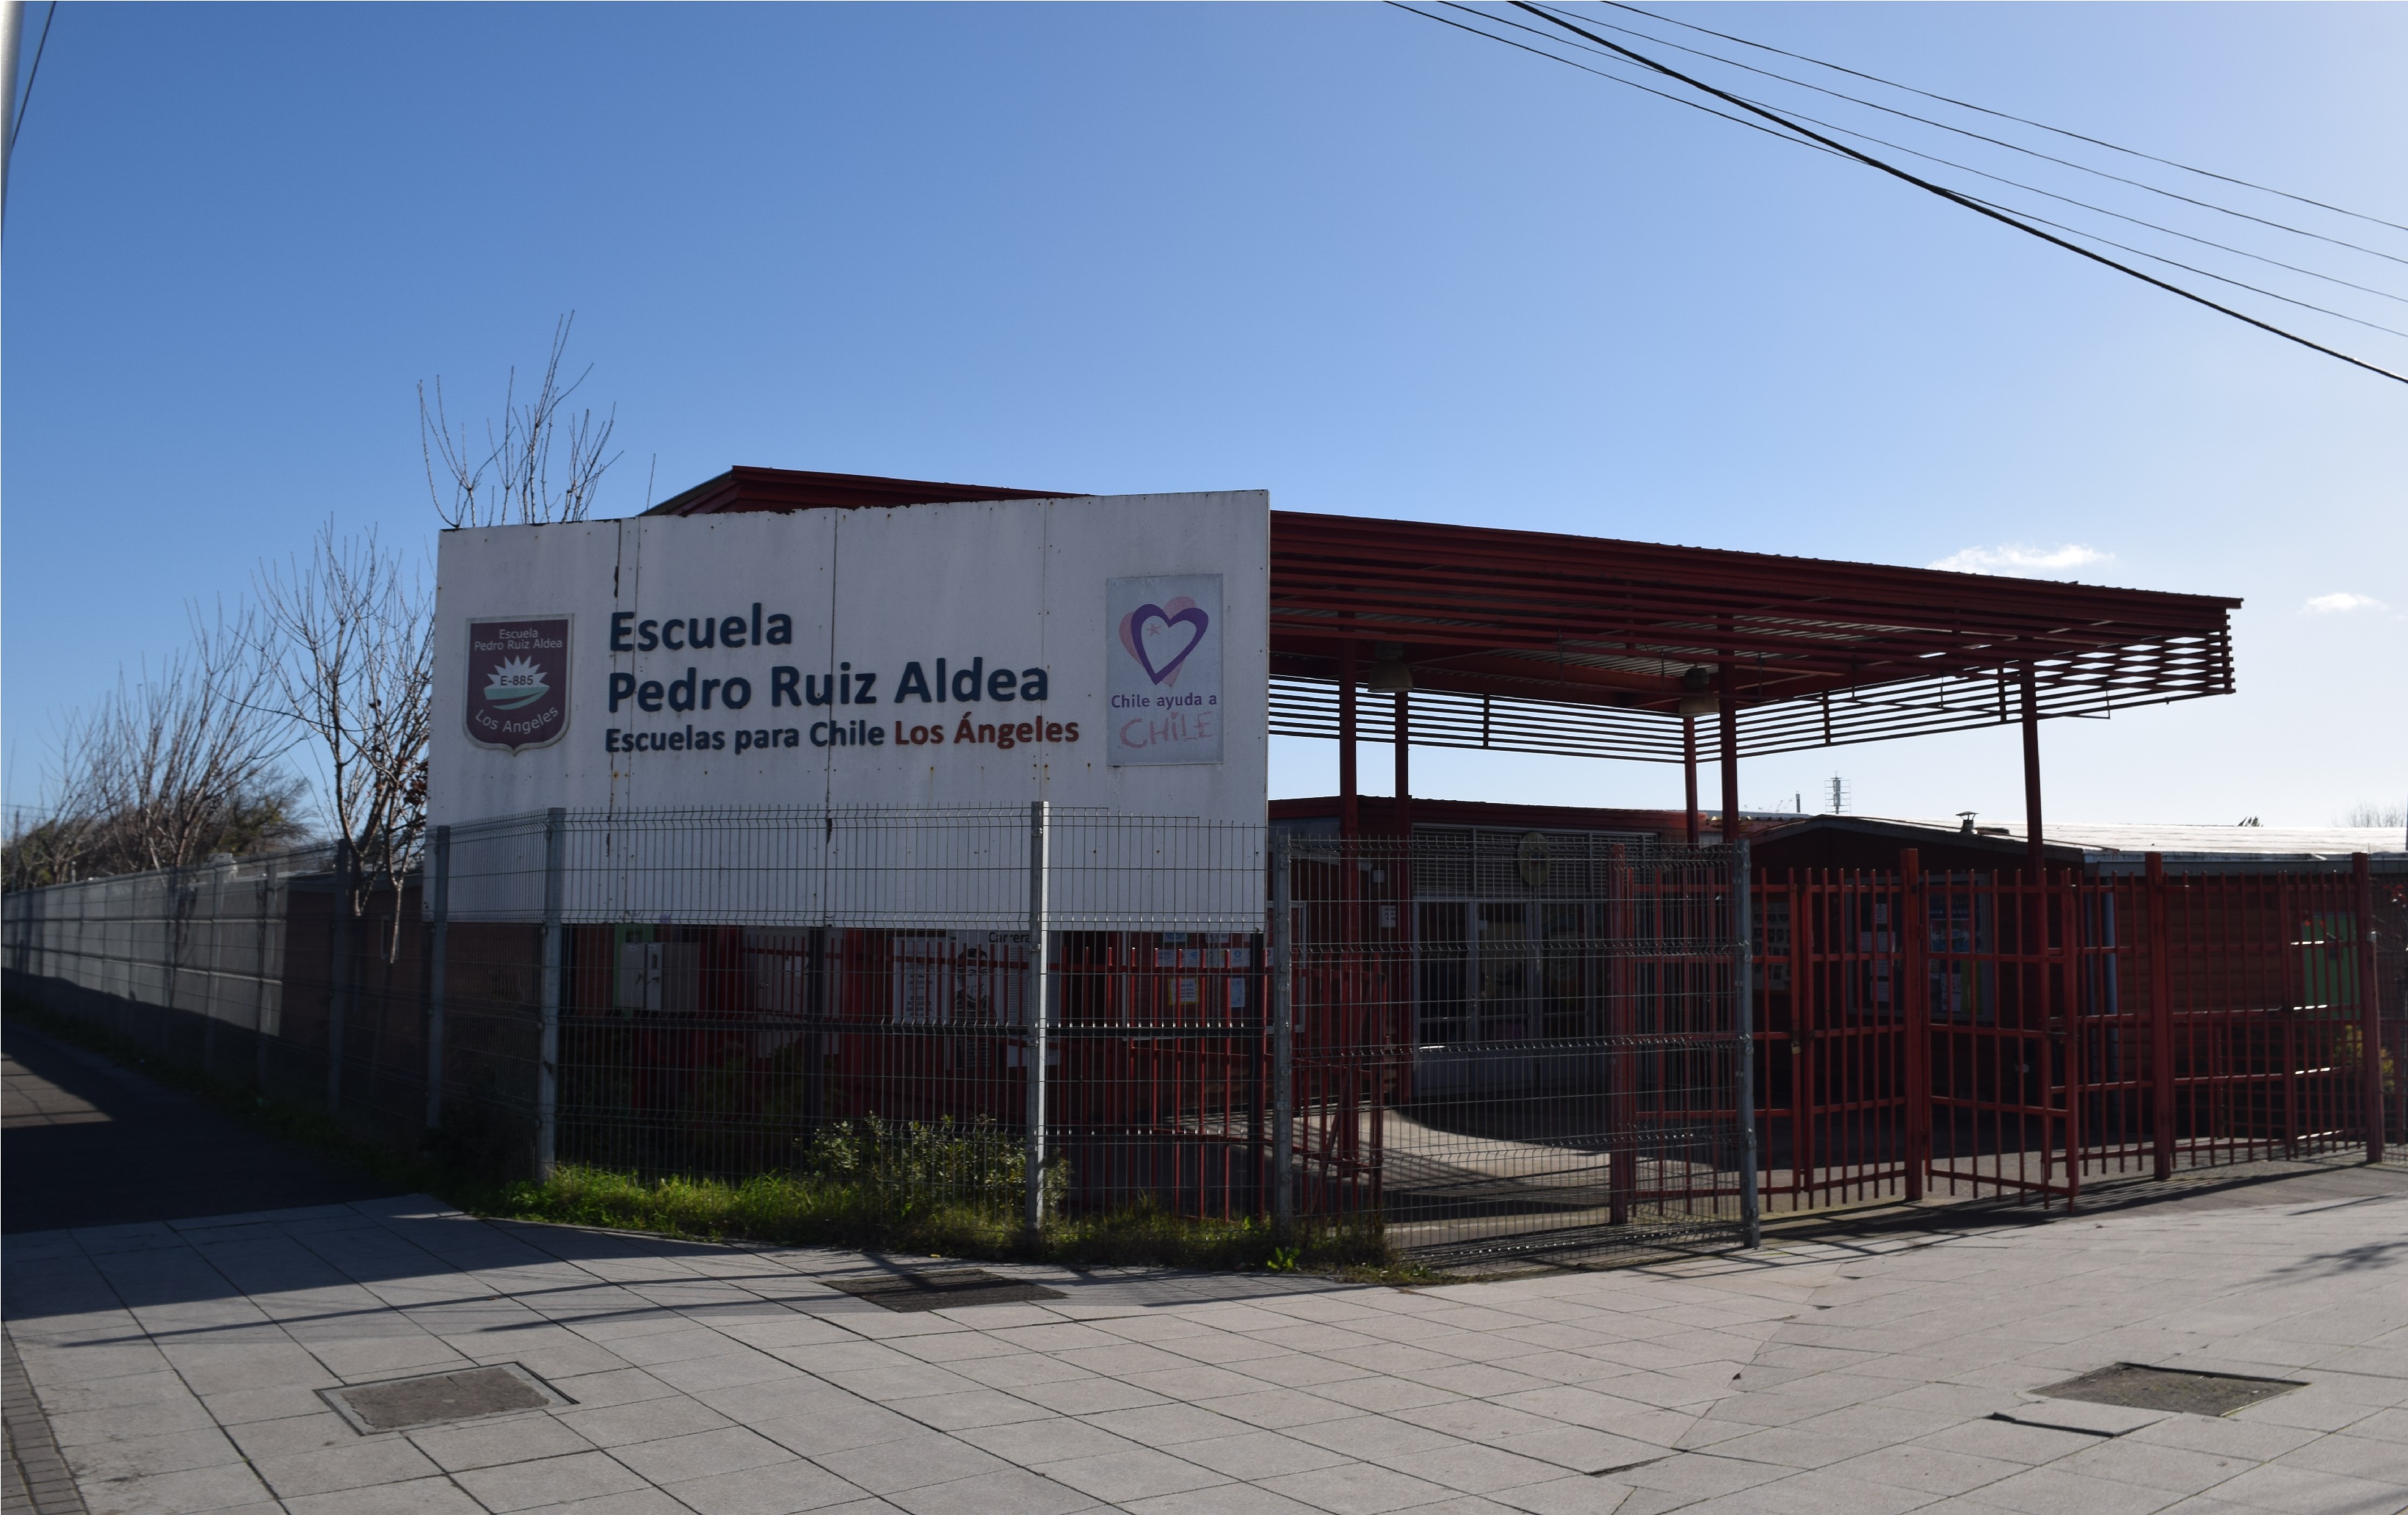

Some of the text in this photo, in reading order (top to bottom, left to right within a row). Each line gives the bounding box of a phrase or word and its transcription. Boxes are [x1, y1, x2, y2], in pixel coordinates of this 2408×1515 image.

[499, 628, 538, 639] Escuela
[610, 602, 792, 652] Escuela
[474, 639, 563, 651] Pedro Ruiz Aldea
[500, 675, 534, 686] E-885
[609, 656, 1048, 713] Pedro Ruiz Aldea
[1111, 692, 1218, 711] Chile ayuda a
[475, 706, 559, 734] Los Angeles
[605, 711, 1080, 755] Escuelas para Chile Los Ángeles
